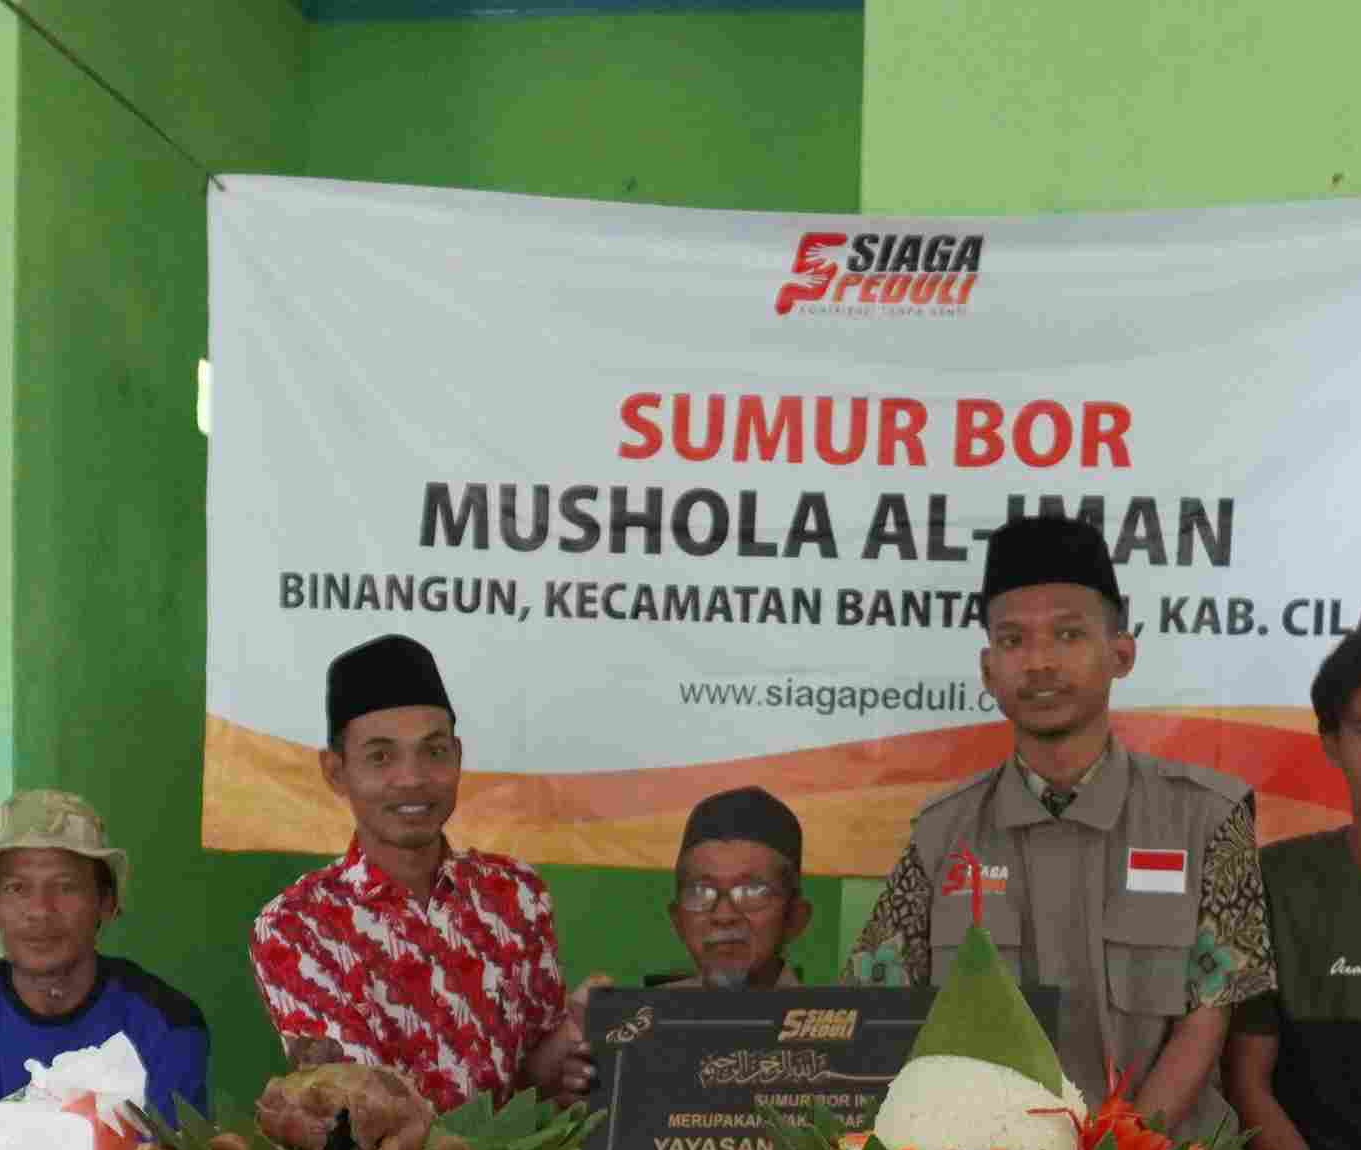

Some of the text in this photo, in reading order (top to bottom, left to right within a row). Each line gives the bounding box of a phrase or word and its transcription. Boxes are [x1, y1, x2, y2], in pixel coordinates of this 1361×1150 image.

[846, 233, 983, 273] SIAGA
[833, 273, 978, 305] PEDULI
[618, 392, 1132, 468] SUMUR BOR
[419, 482, 839, 558] MUSHOLA
[279, 571, 532, 622] BINANGUN,
[544, 580, 822, 625] KECAMATAN
[1158, 597, 1269, 636] KAB.
